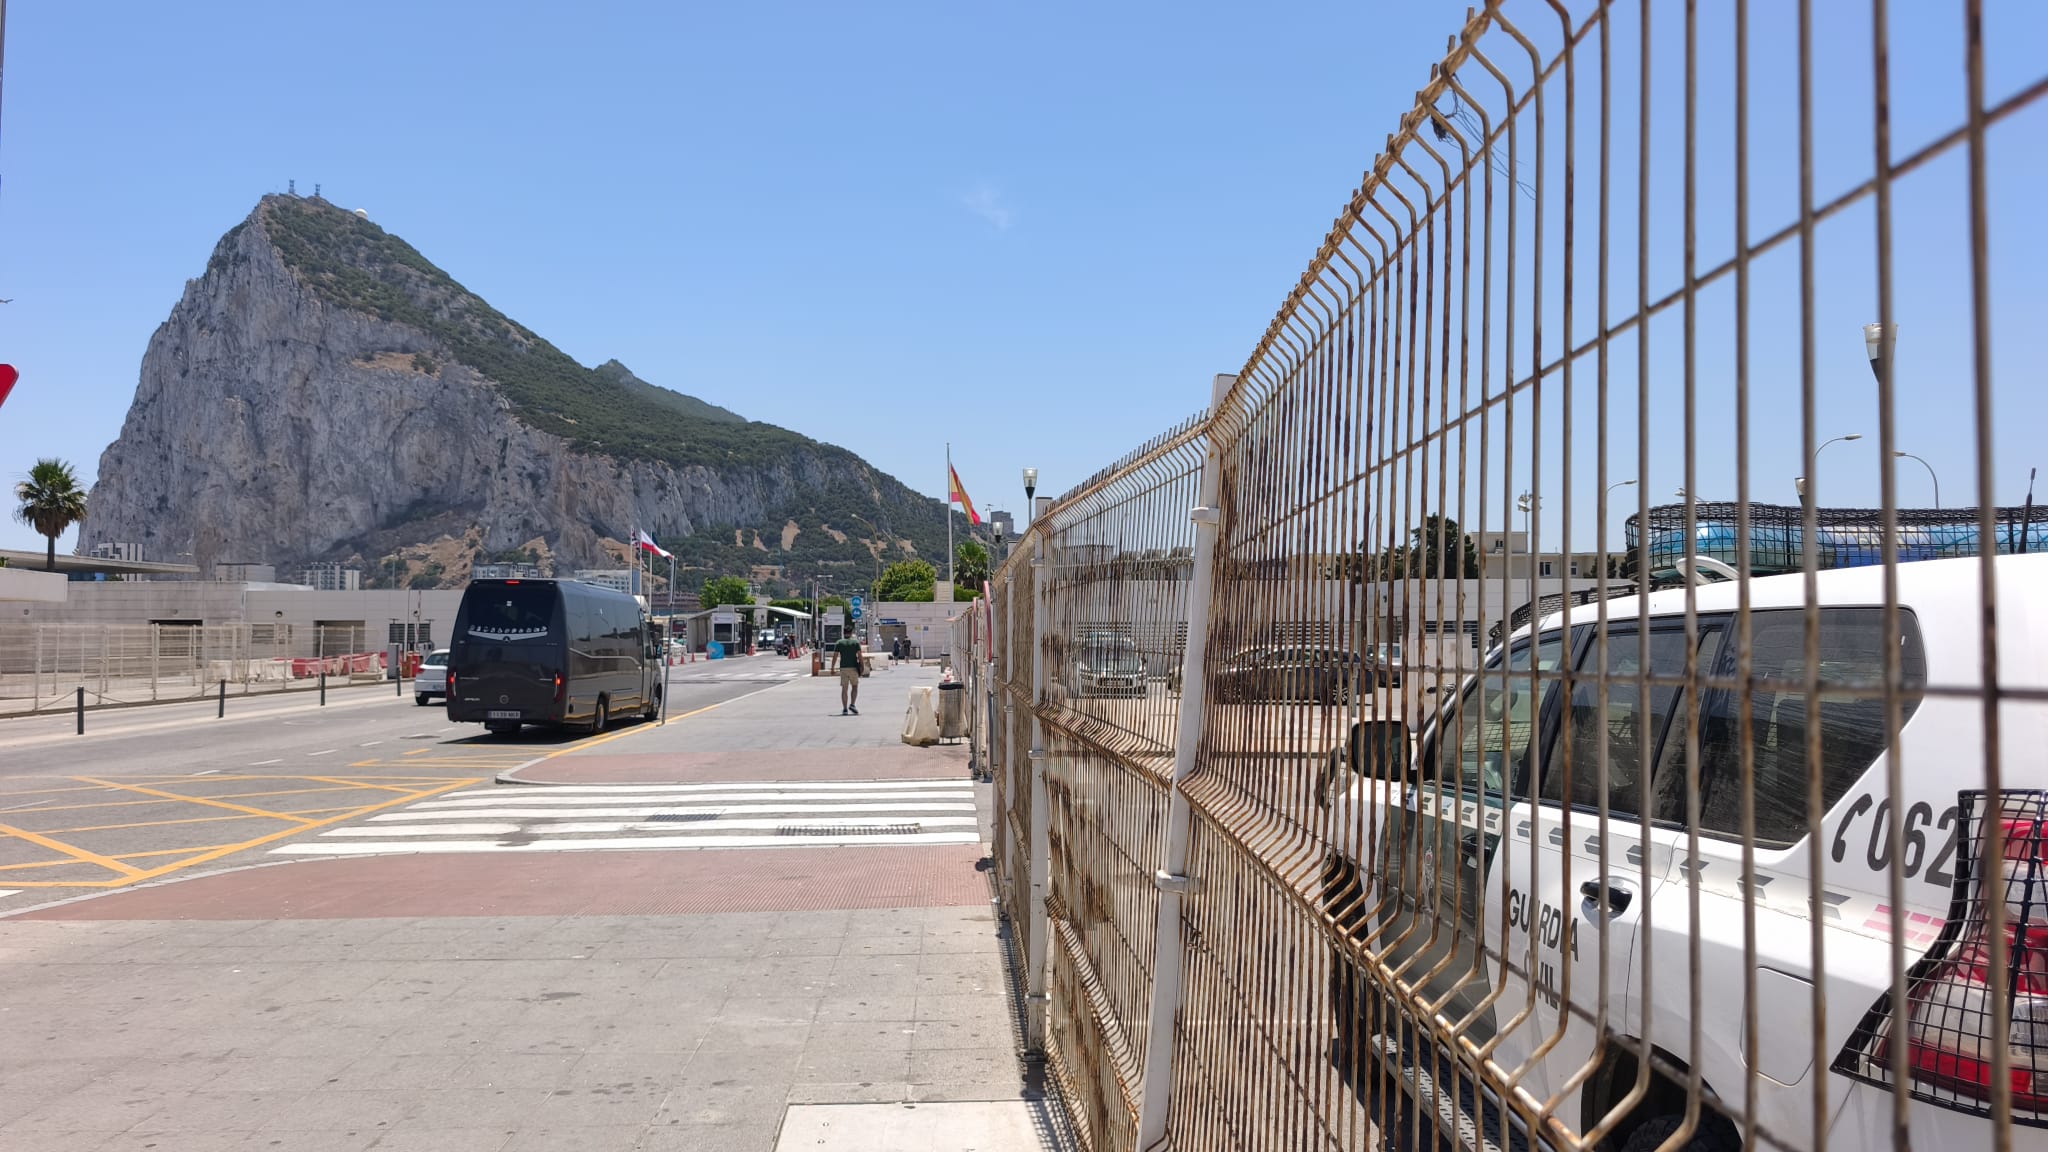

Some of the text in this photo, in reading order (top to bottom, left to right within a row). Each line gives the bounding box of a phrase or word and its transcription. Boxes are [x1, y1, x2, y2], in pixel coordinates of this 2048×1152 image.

[1867, 797, 1959, 888] 062
[1507, 889, 1579, 962] GURDA
[1523, 949, 1558, 1011] CVIL
